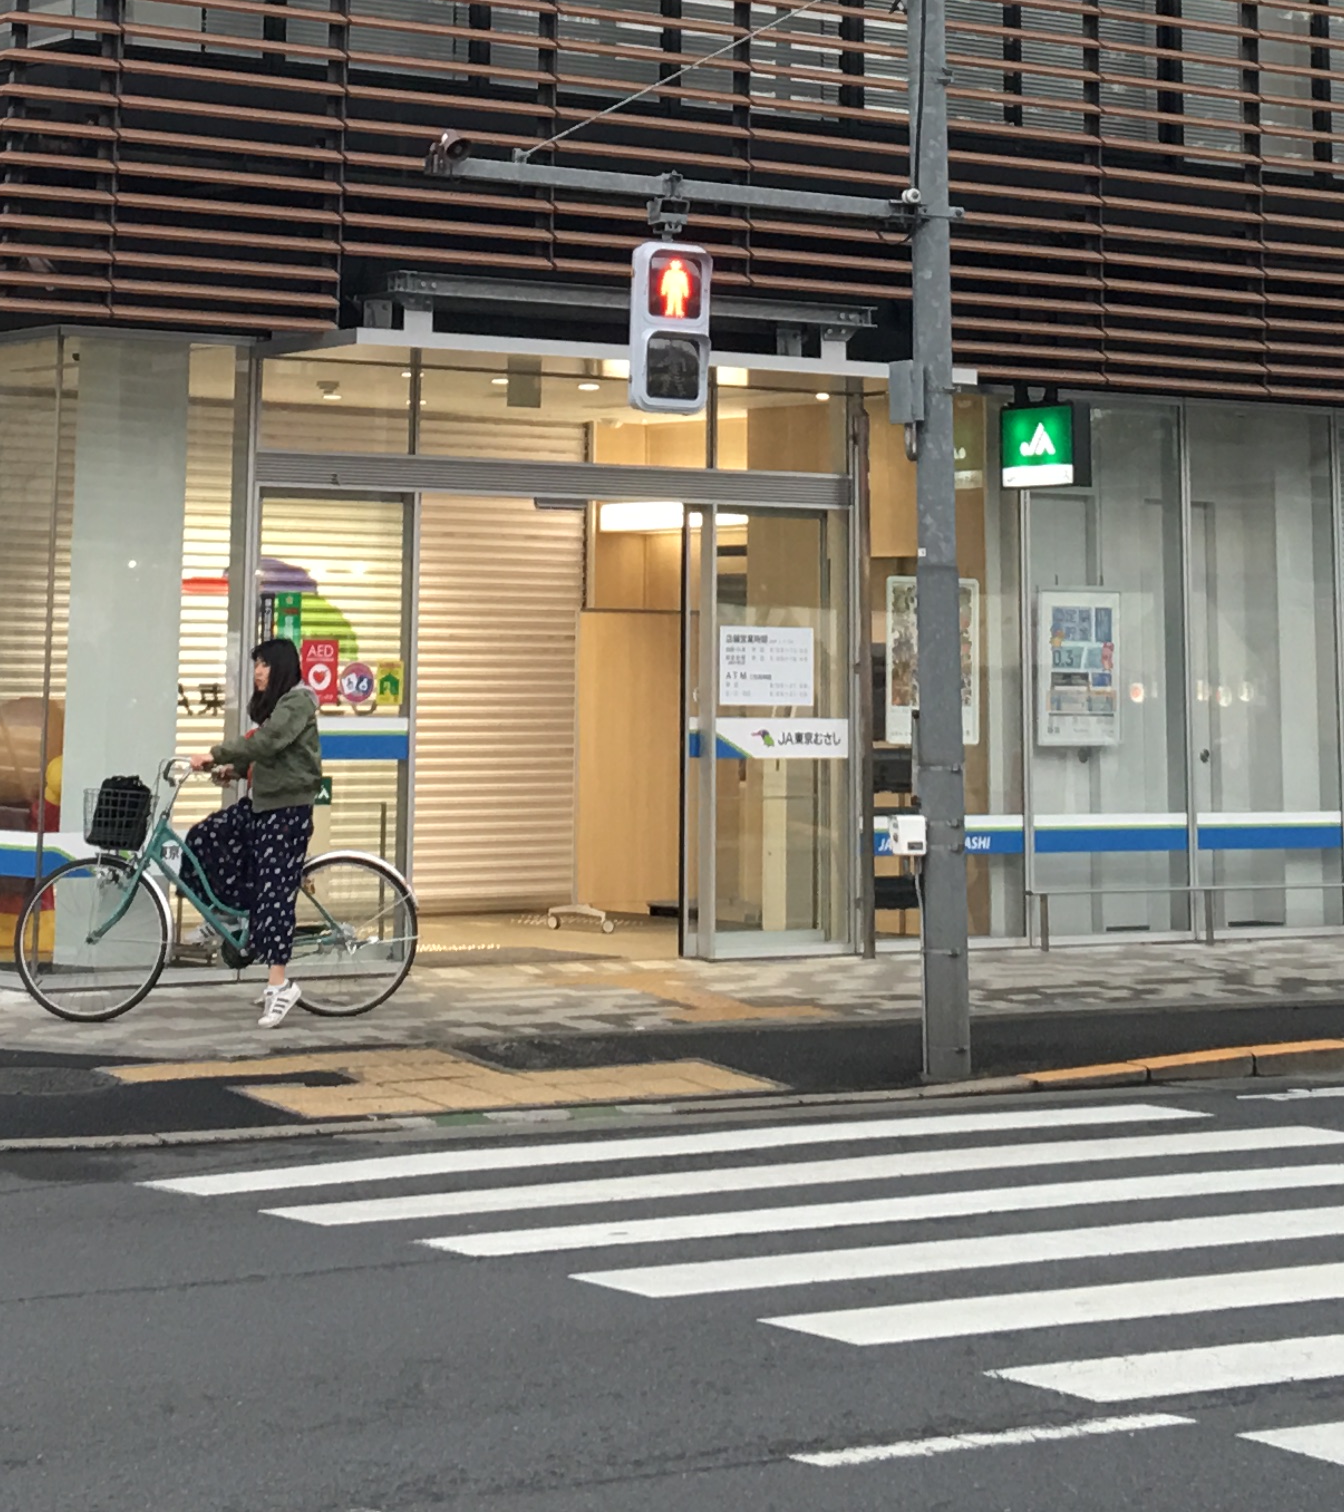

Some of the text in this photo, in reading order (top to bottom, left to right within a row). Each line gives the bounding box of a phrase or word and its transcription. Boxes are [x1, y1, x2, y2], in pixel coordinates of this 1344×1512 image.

[307, 644, 334, 657] AED
[777, 731, 841, 746] JA東京むさし
